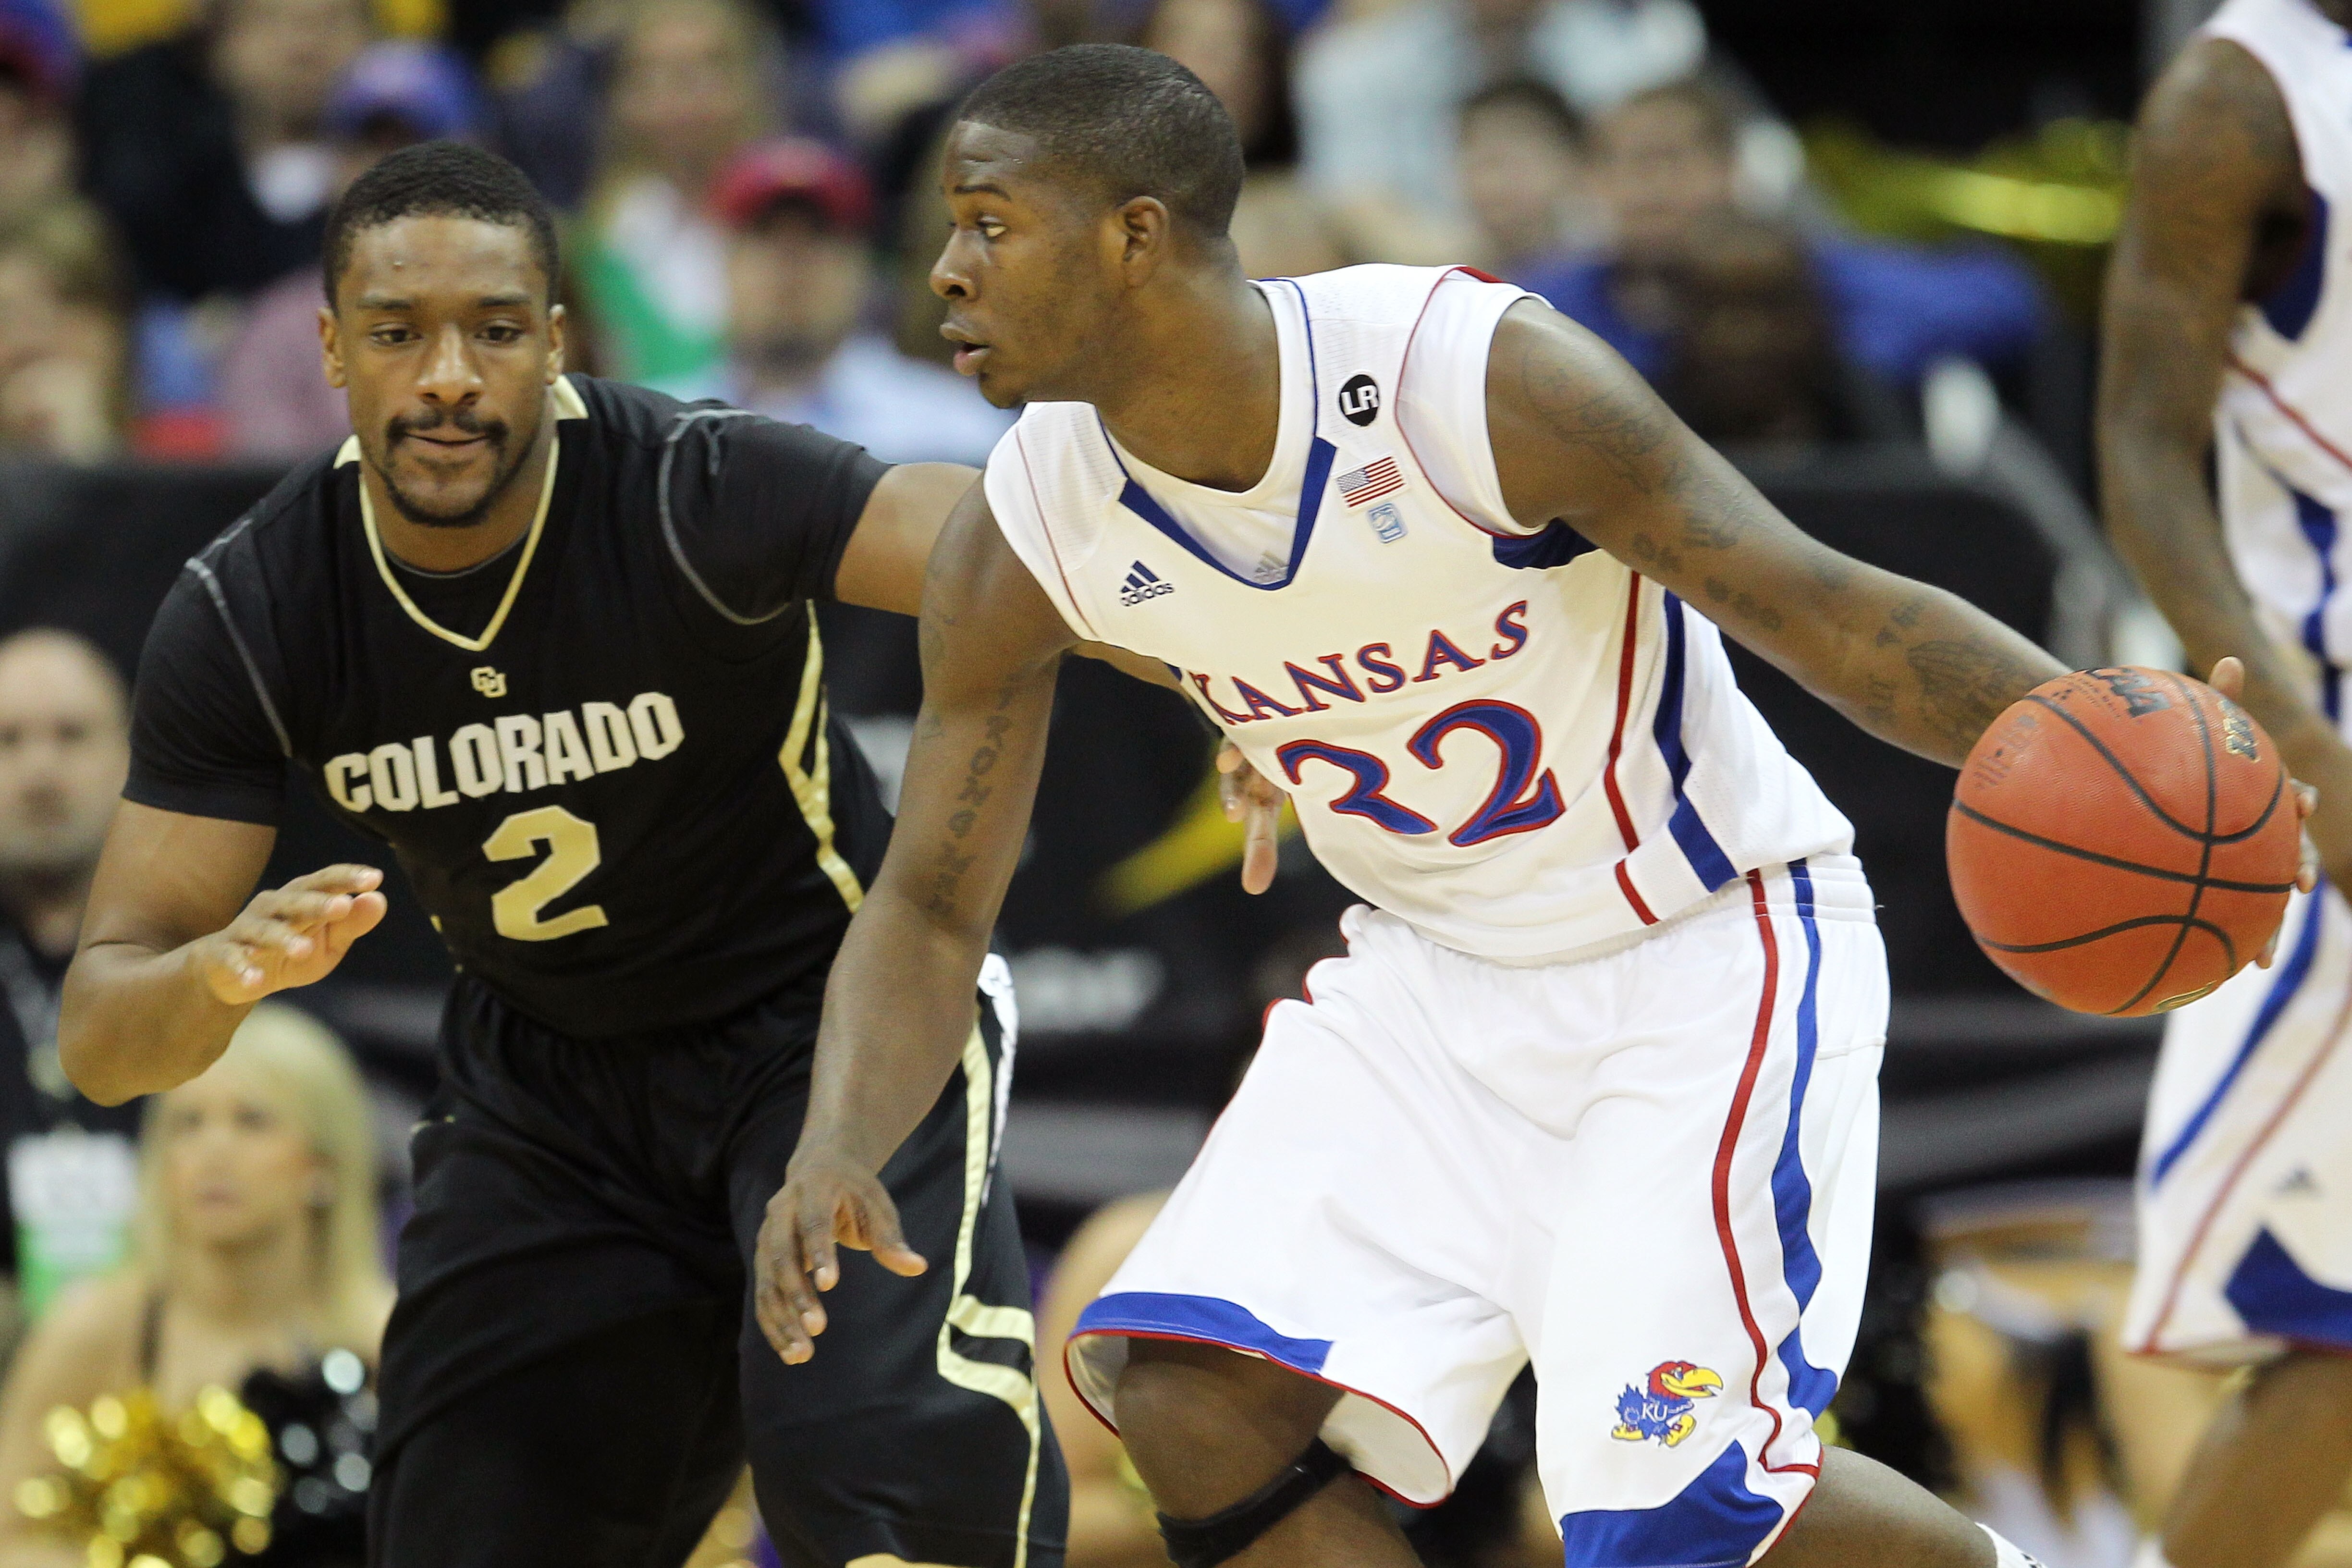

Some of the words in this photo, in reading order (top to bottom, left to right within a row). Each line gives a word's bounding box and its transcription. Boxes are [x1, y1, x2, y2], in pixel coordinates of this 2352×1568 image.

[1341, 384, 1379, 416] LR
[1120, 583, 1174, 606] adidas
[1188, 600, 1529, 726] KANSAS
[323, 692, 685, 813] COLORADO
[1276, 699, 1566, 847] 32
[482, 805, 609, 942] 2
[1642, 1401, 1668, 1423] KU
